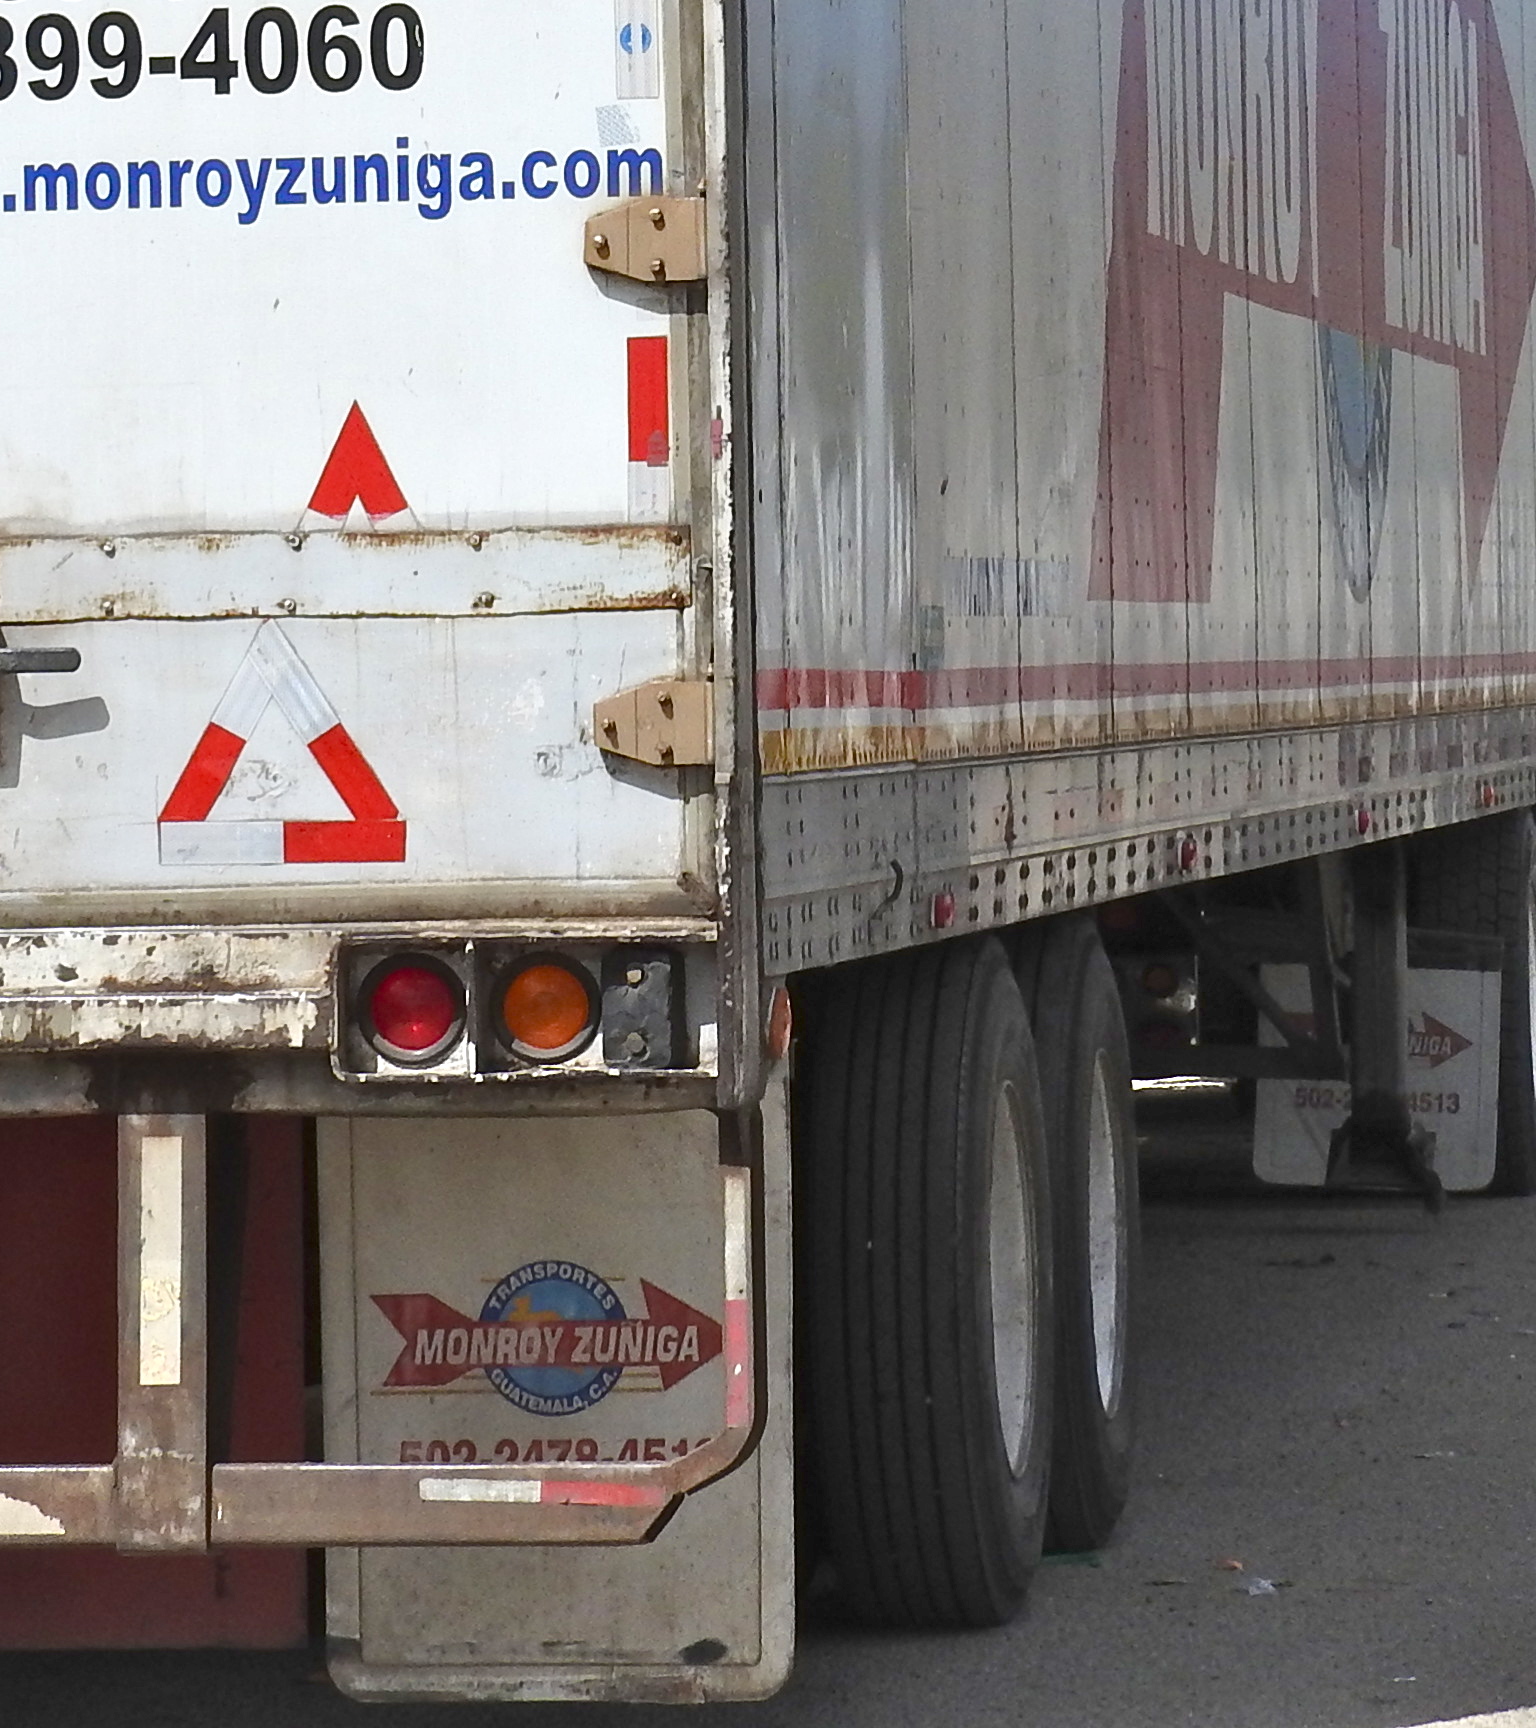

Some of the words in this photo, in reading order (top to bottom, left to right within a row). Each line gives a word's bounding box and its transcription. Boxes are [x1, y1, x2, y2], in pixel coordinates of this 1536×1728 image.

[488, 1263, 615, 1311] TRANSPORTES
[414, 1327, 564, 1365] MONROY
[491, 1368, 588, 1413] GUATEMALA,
[591, 1371, 618, 1400] C.A.
